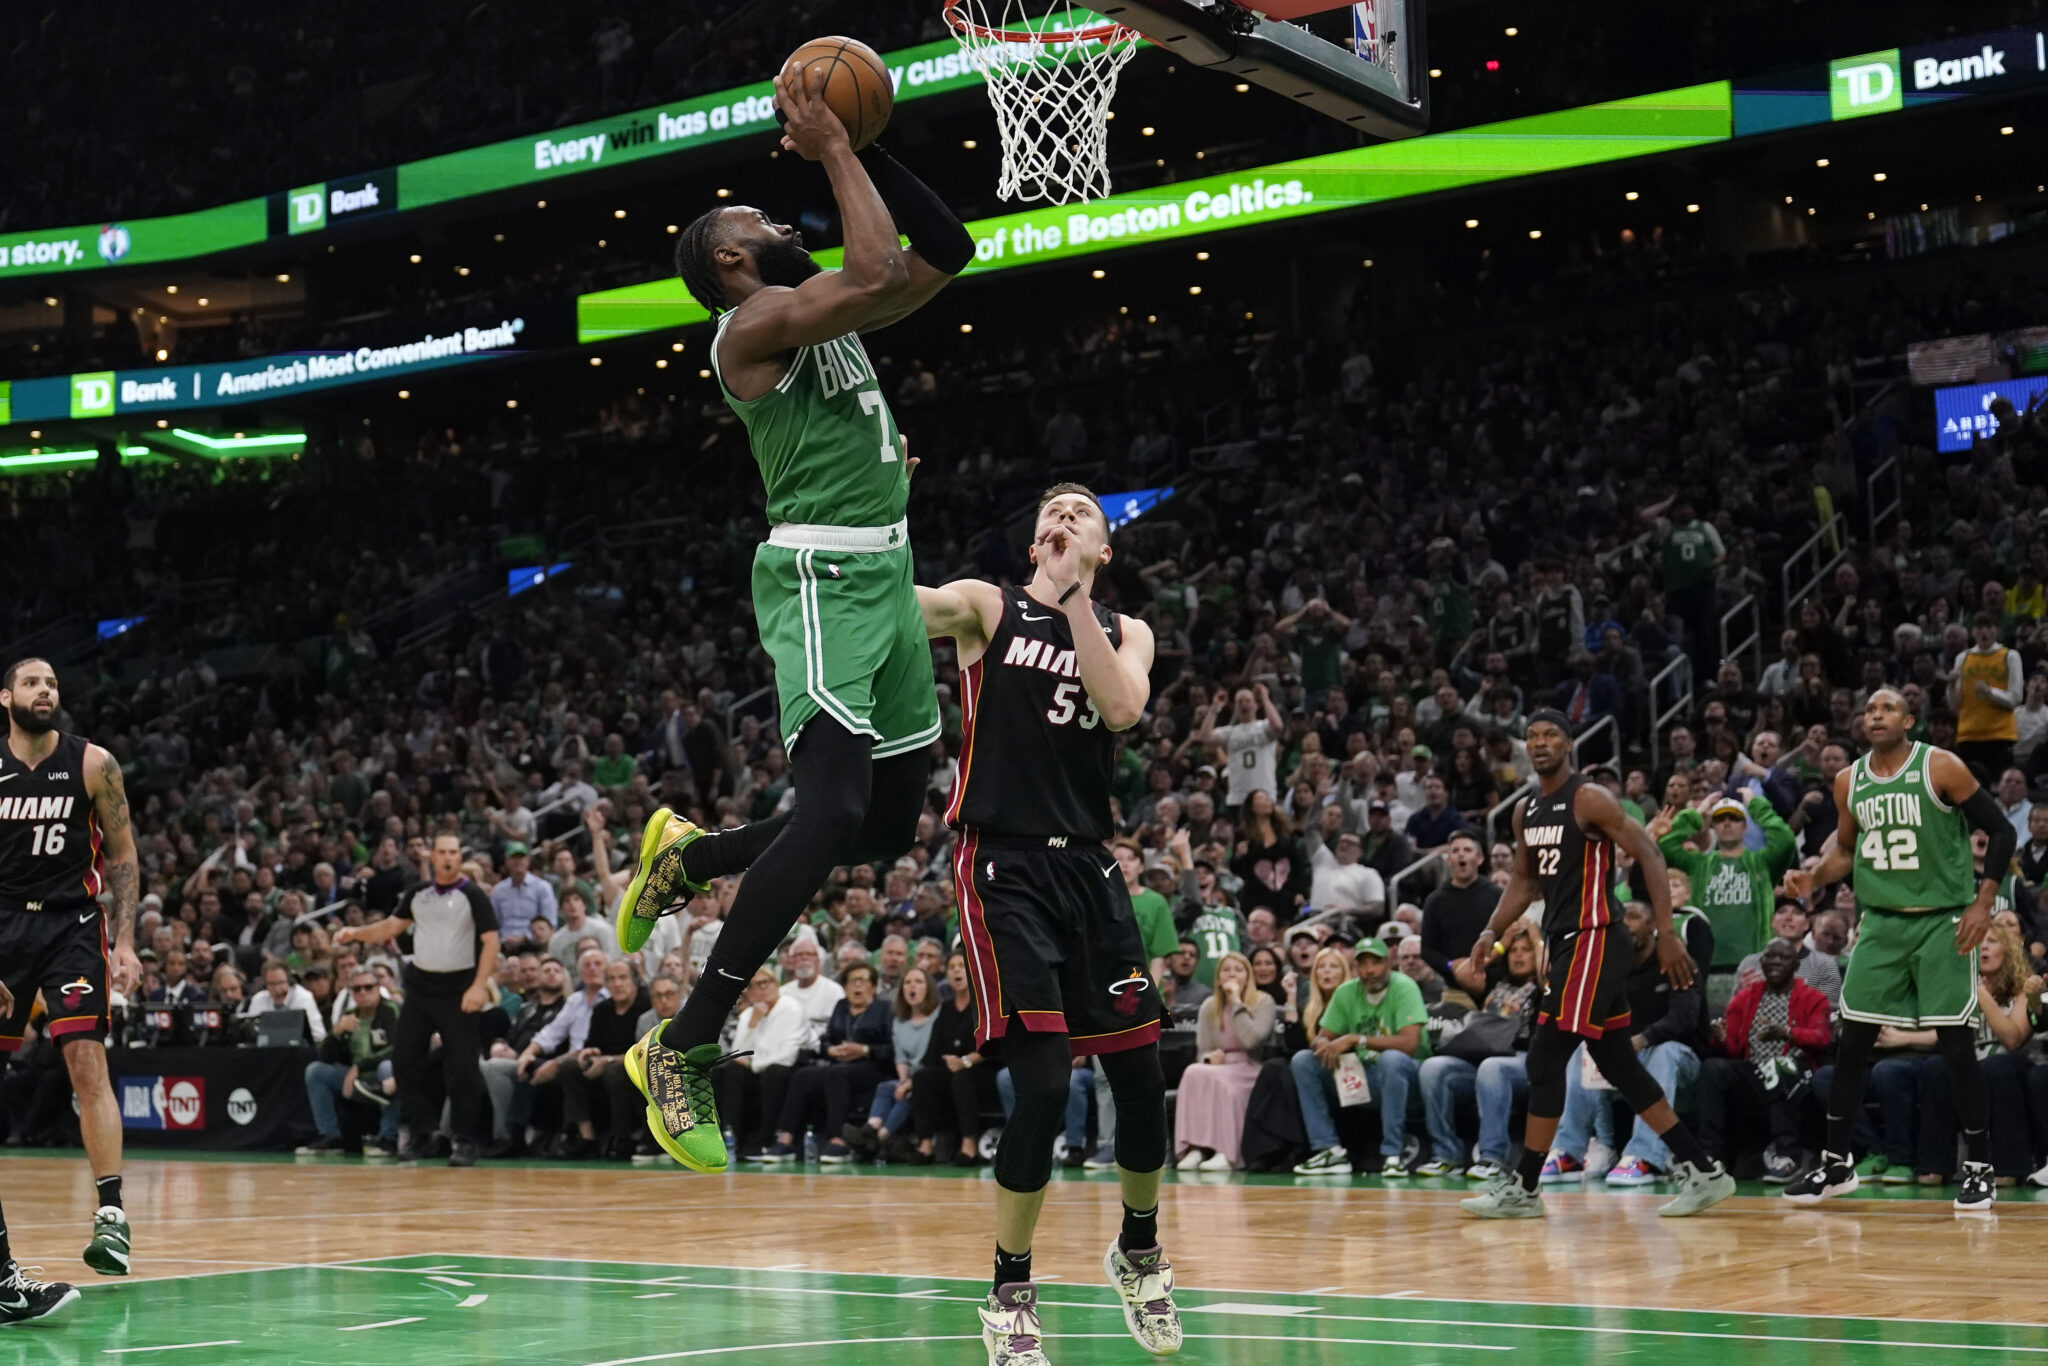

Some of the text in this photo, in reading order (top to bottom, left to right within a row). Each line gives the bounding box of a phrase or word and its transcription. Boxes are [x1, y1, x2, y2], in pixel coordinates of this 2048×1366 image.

[1836, 45, 2006, 106] TD Bank
[534, 95, 776, 170] Every win has a sto
[291, 182, 379, 224] TD Bank
[975, 179, 1313, 261] of the Boston Celtics.
[11, 239, 84, 266] story.
[216, 360, 308, 396] America's
[308, 352, 355, 380] Most
[354, 331, 463, 371] Convenient
[75, 377, 178, 410] TD Bank
[857, 390, 898, 463] 7
[1002, 635, 1081, 678] MIA
[47, 771, 69, 780] UKG
[1855, 792, 1922, 832] BOSTON
[31, 823, 67, 856] 16
[1861, 829, 1919, 870] 42
[1537, 848, 1561, 875] 22
[1205, 932, 1230, 958] 11
[662, 1052, 676, 1068] 12
[673, 1074, 682, 1089] NBA
[169, 1097, 200, 1113] TNT
[229, 1101, 257, 1115] TNT
